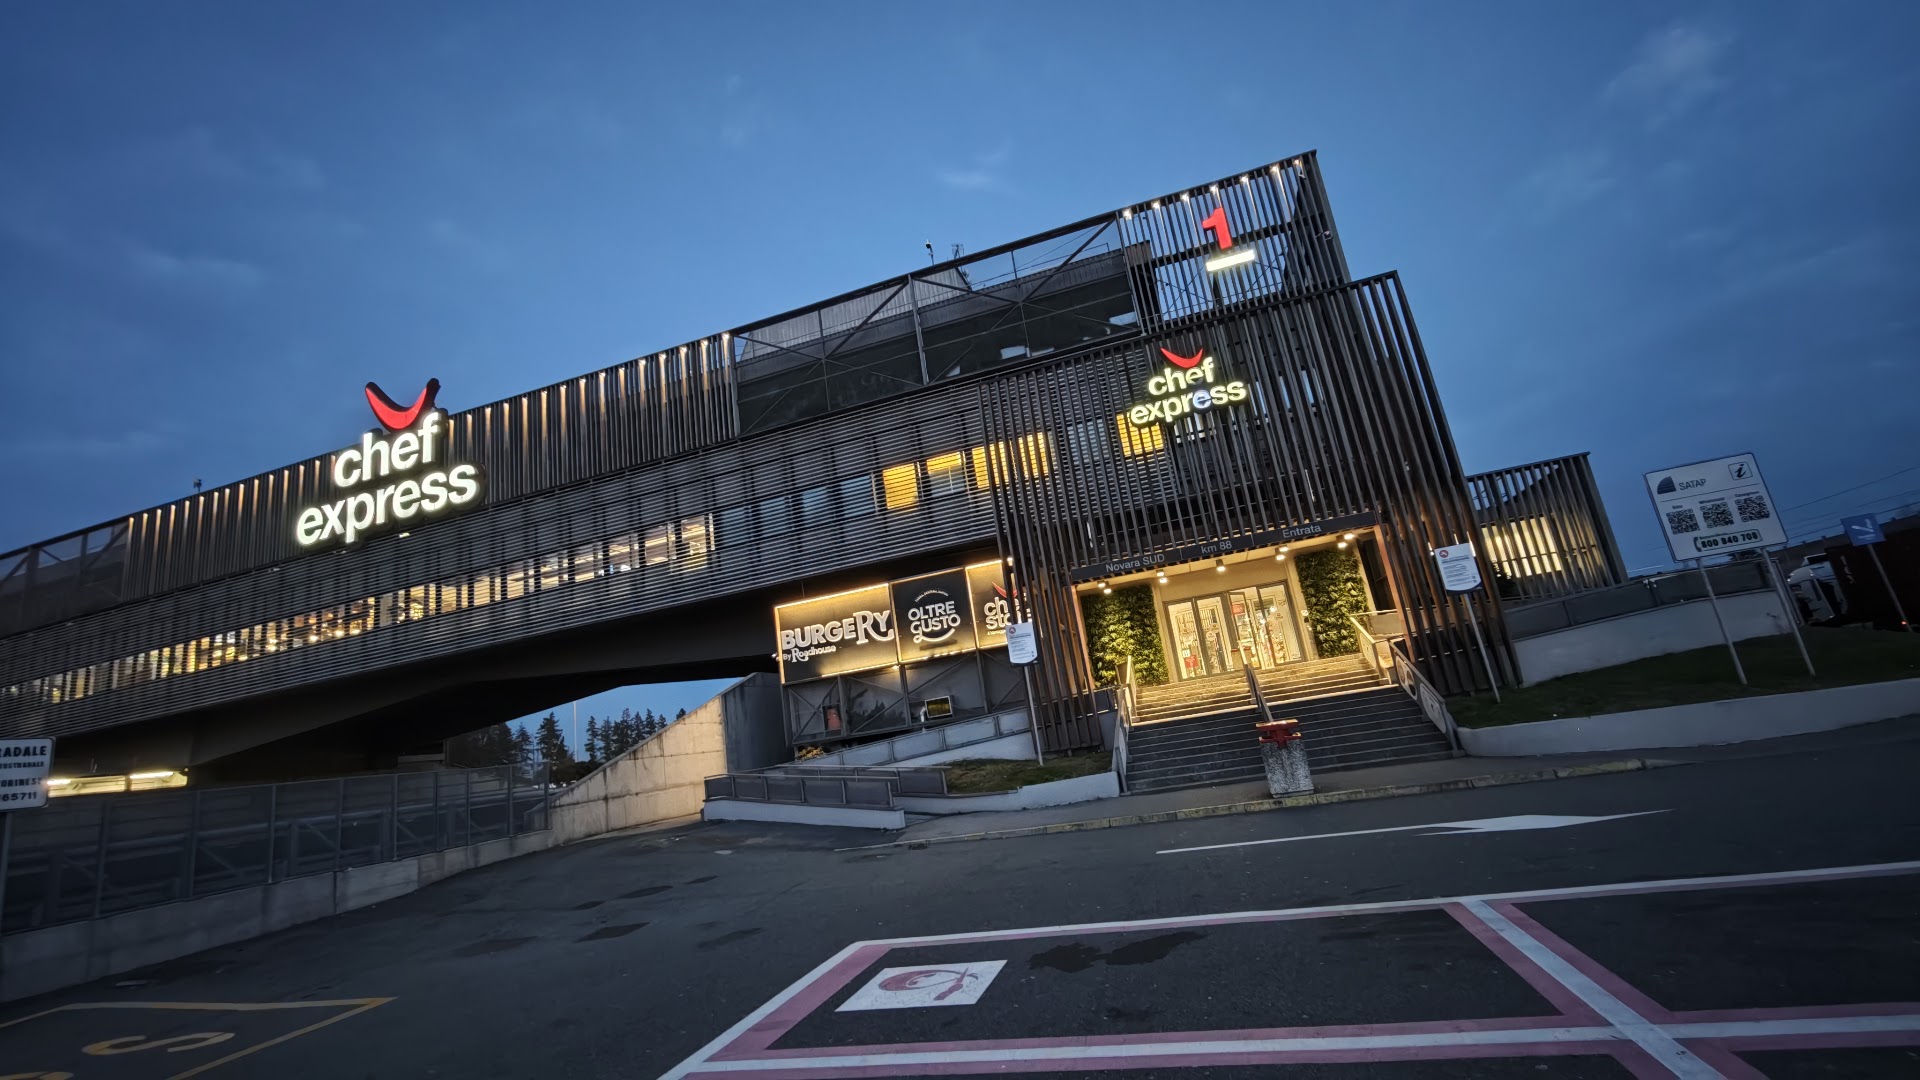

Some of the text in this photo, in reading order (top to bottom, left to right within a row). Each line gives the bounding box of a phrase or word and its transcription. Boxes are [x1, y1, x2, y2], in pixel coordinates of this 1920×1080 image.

[1202, 207, 1232, 250] 1
[1149, 356, 1214, 396] chef
[1130, 381, 1247, 424] express
[334, 412, 439, 488] chef
[1678, 478, 1707, 491] SATAP
[297, 464, 478, 545] express
[1282, 524, 1322, 538] Entrata
[1701, 539, 1719, 549] 800
[1740, 531, 1759, 542] 708
[1200, 540, 1232, 555] km 88
[1105, 552, 1165, 573] Novara SUD
[908, 600, 956, 621] OLTRE
[781, 610, 895, 650] BURGERY
[910, 613, 961, 643] GUSTO
[783, 645, 837, 663] By Roadhouse
[0, 745, 47, 758] ADALE
[0, 792, 37, 801] 65711
